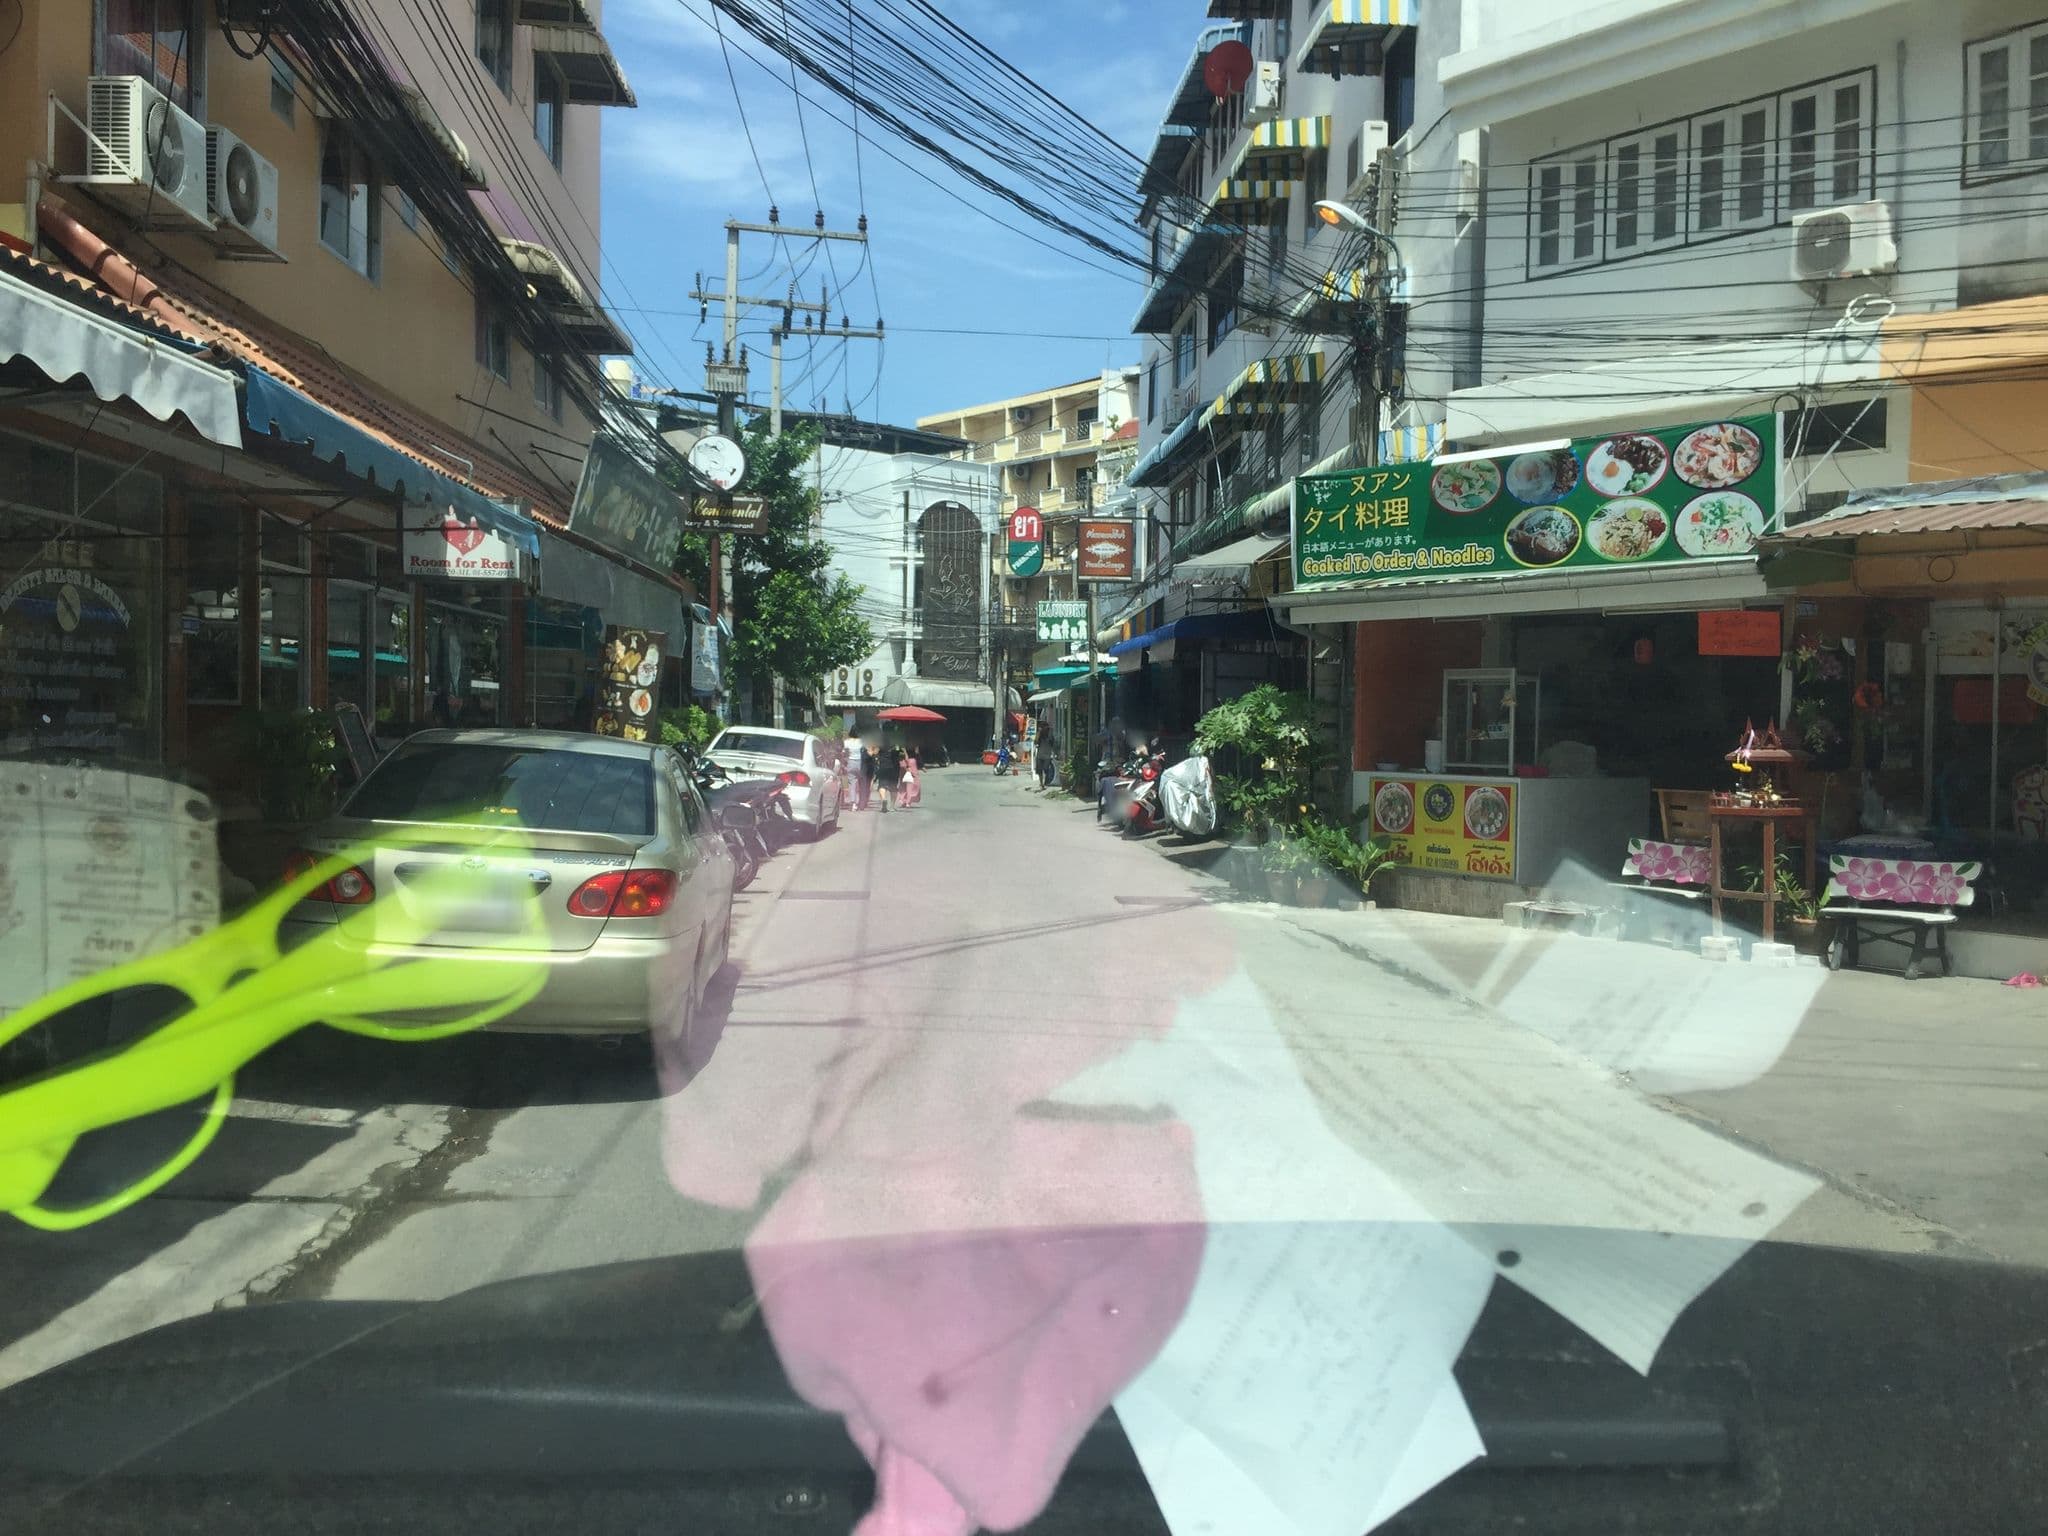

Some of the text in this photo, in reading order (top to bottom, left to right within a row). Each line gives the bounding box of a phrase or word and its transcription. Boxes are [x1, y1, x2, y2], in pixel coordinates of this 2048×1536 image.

[1350, 473, 1410, 496] ヌアン
[1014, 516, 1038, 538] ยา
[1303, 497, 1410, 535] タイ料理
[1302, 536, 1417, 555] 日本語メニューがあります。
[410, 555, 515, 569] Room for Rent
[1012, 545, 1039, 570] PHARMACY
[1304, 543, 1493, 574] Cooked To Order & Noodles
[1038, 603, 1087, 618] LAUNDRY
